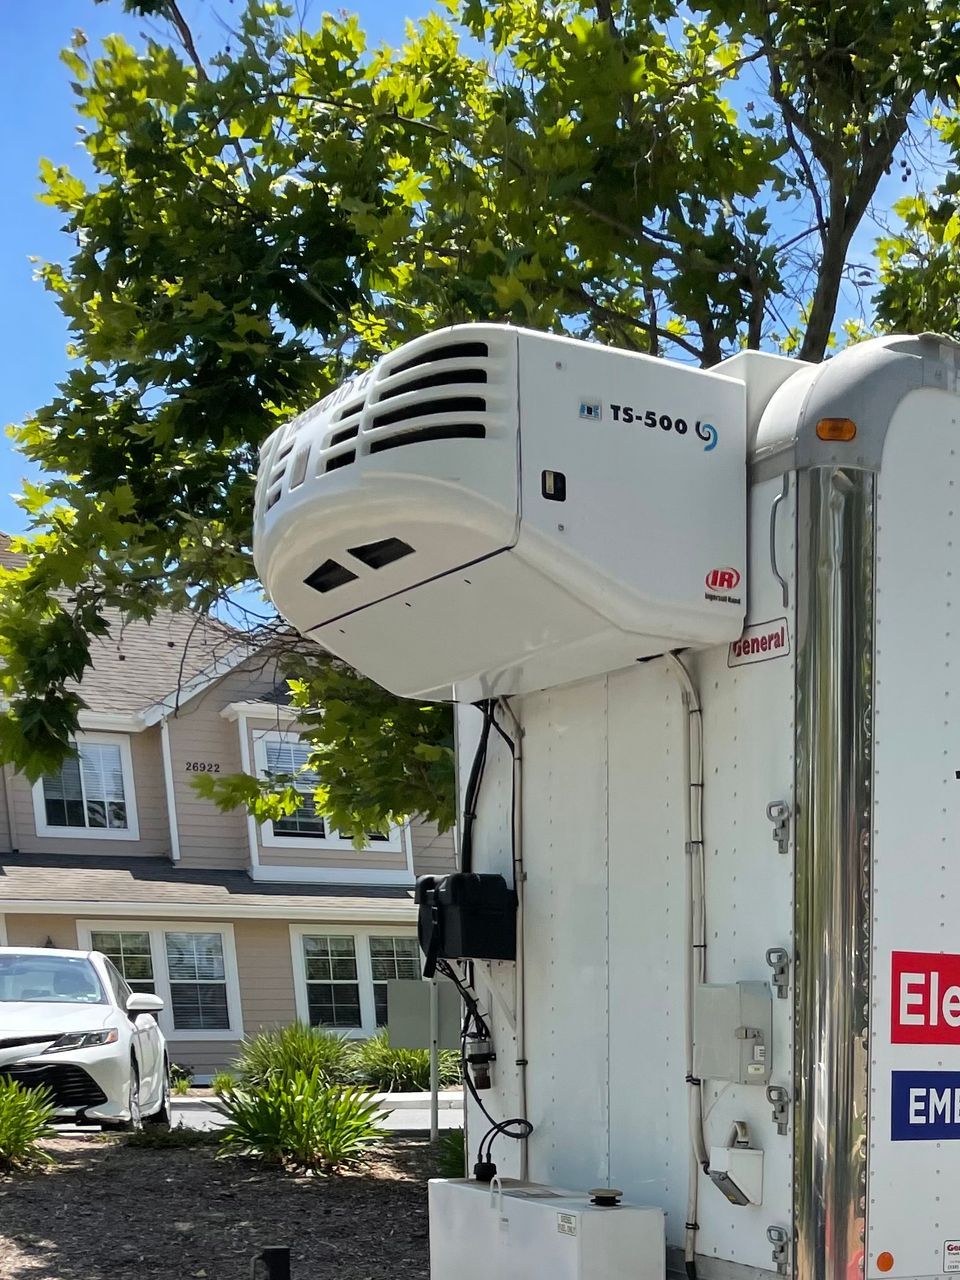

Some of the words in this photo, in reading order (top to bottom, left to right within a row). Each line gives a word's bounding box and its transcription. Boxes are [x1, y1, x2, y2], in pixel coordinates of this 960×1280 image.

[610, 404, 688, 435] TS-500
[710, 569, 734, 590] IR
[732, 626, 785, 657] General
[185, 761, 220, 773] 26922
